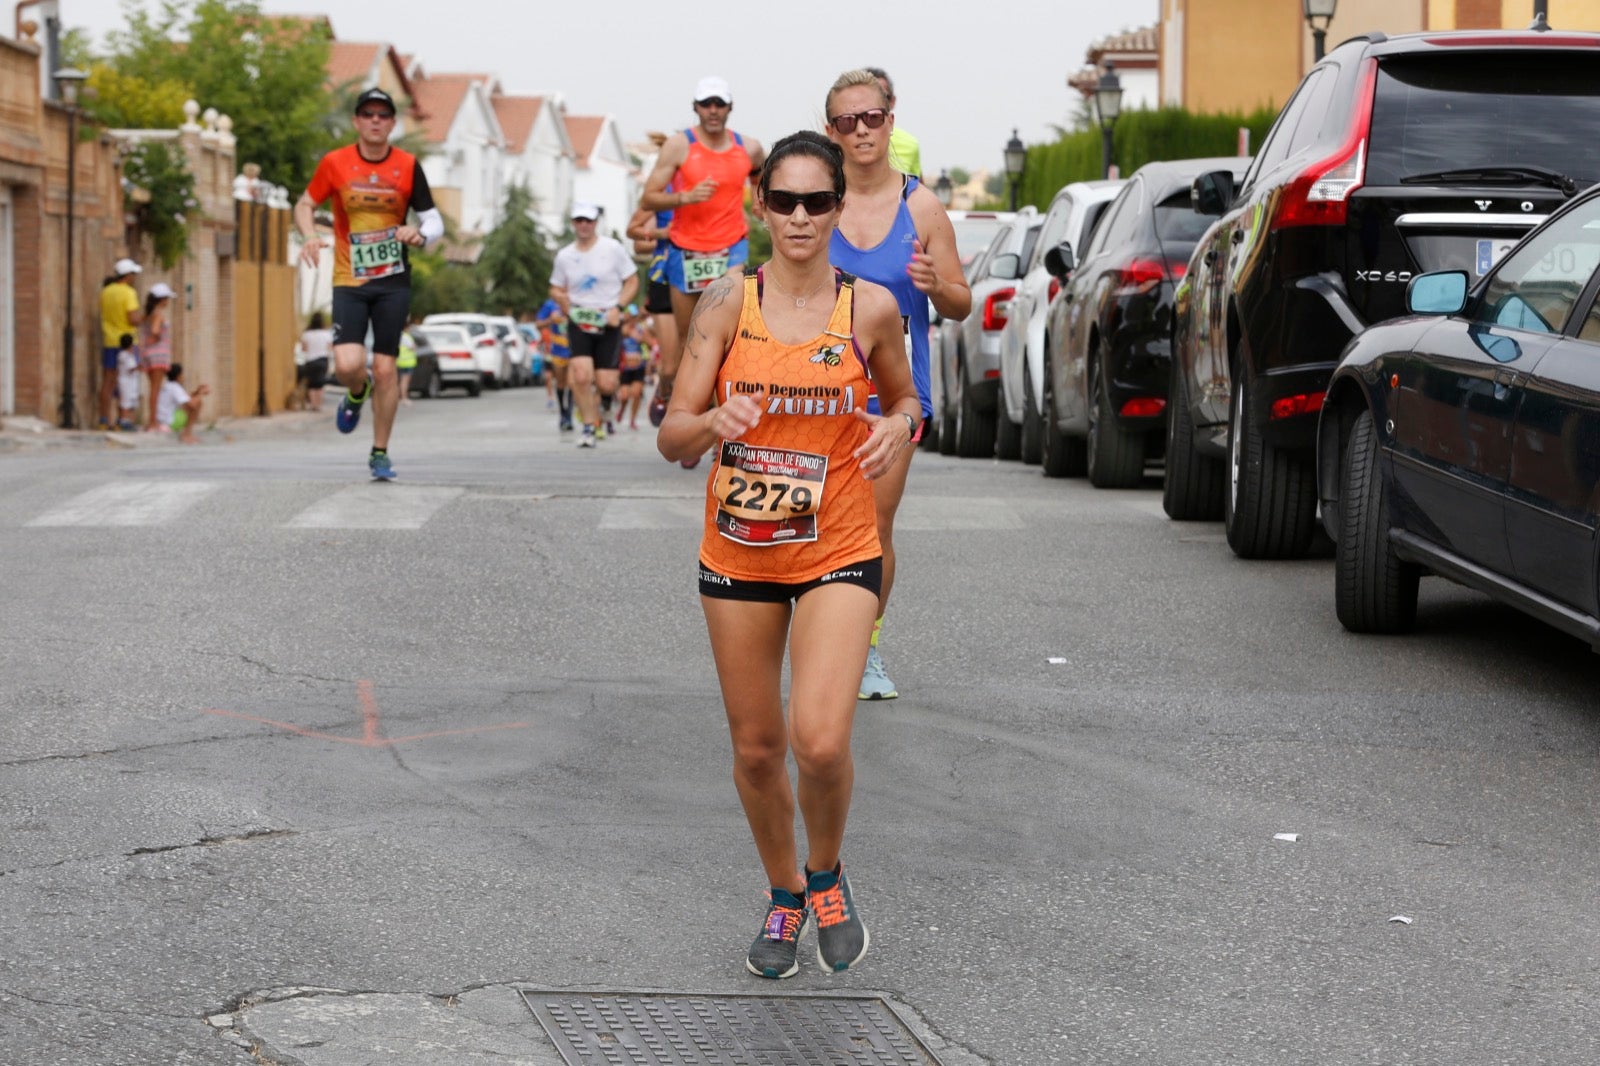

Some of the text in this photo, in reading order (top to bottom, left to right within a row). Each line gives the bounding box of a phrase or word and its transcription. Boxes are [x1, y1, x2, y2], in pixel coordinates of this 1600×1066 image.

[355, 241, 401, 263] 1188
[693, 260, 725, 277] 567
[1481, 261, 1489, 269] E
[735, 381, 841, 398] Club Deportivo
[767, 385, 854, 416] ZUBIA
[757, 451, 784, 465] PREMIO
[785, 454, 794, 466] DE
[795, 455, 819, 469] FONDO
[725, 476, 812, 513] 2279
